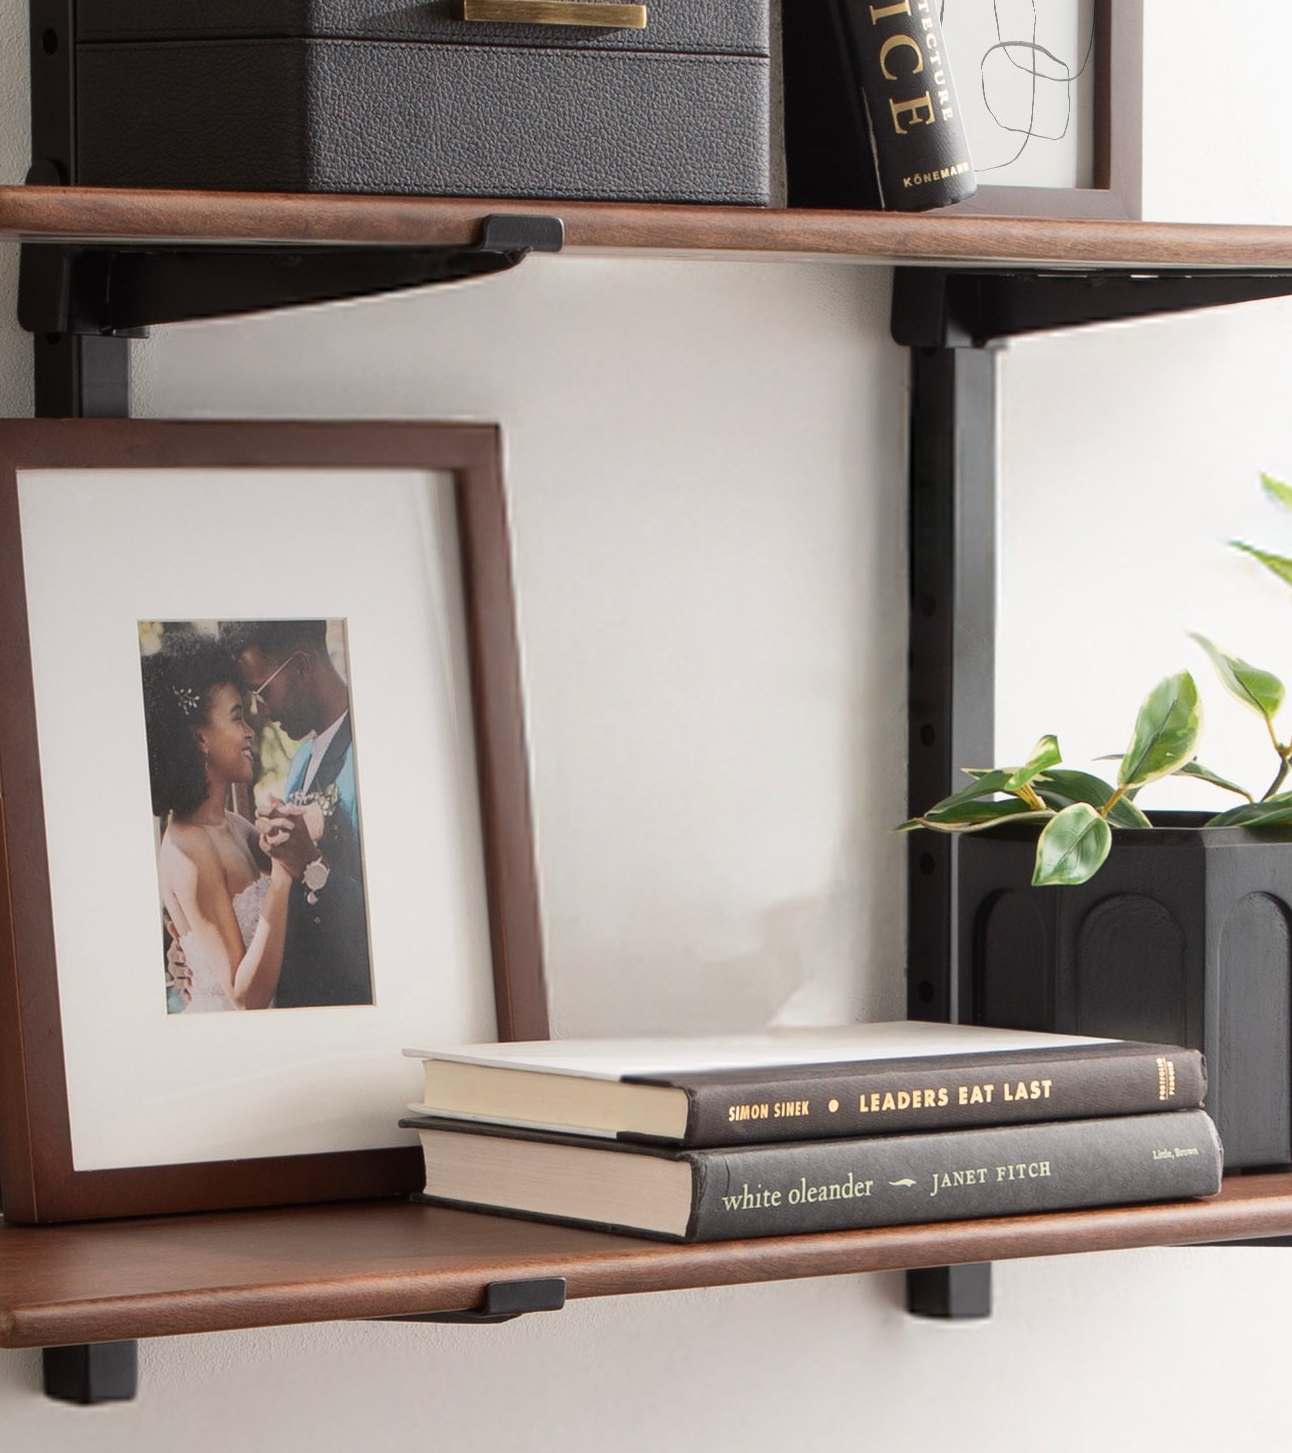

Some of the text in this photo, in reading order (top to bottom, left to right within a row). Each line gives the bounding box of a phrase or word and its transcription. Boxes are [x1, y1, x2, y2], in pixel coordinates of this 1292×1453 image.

[728, 1079, 1053, 1122] SIMON SINEK LEADERS EAT LAST
[722, 1161, 1052, 1211] white oleander JANET FITCH
